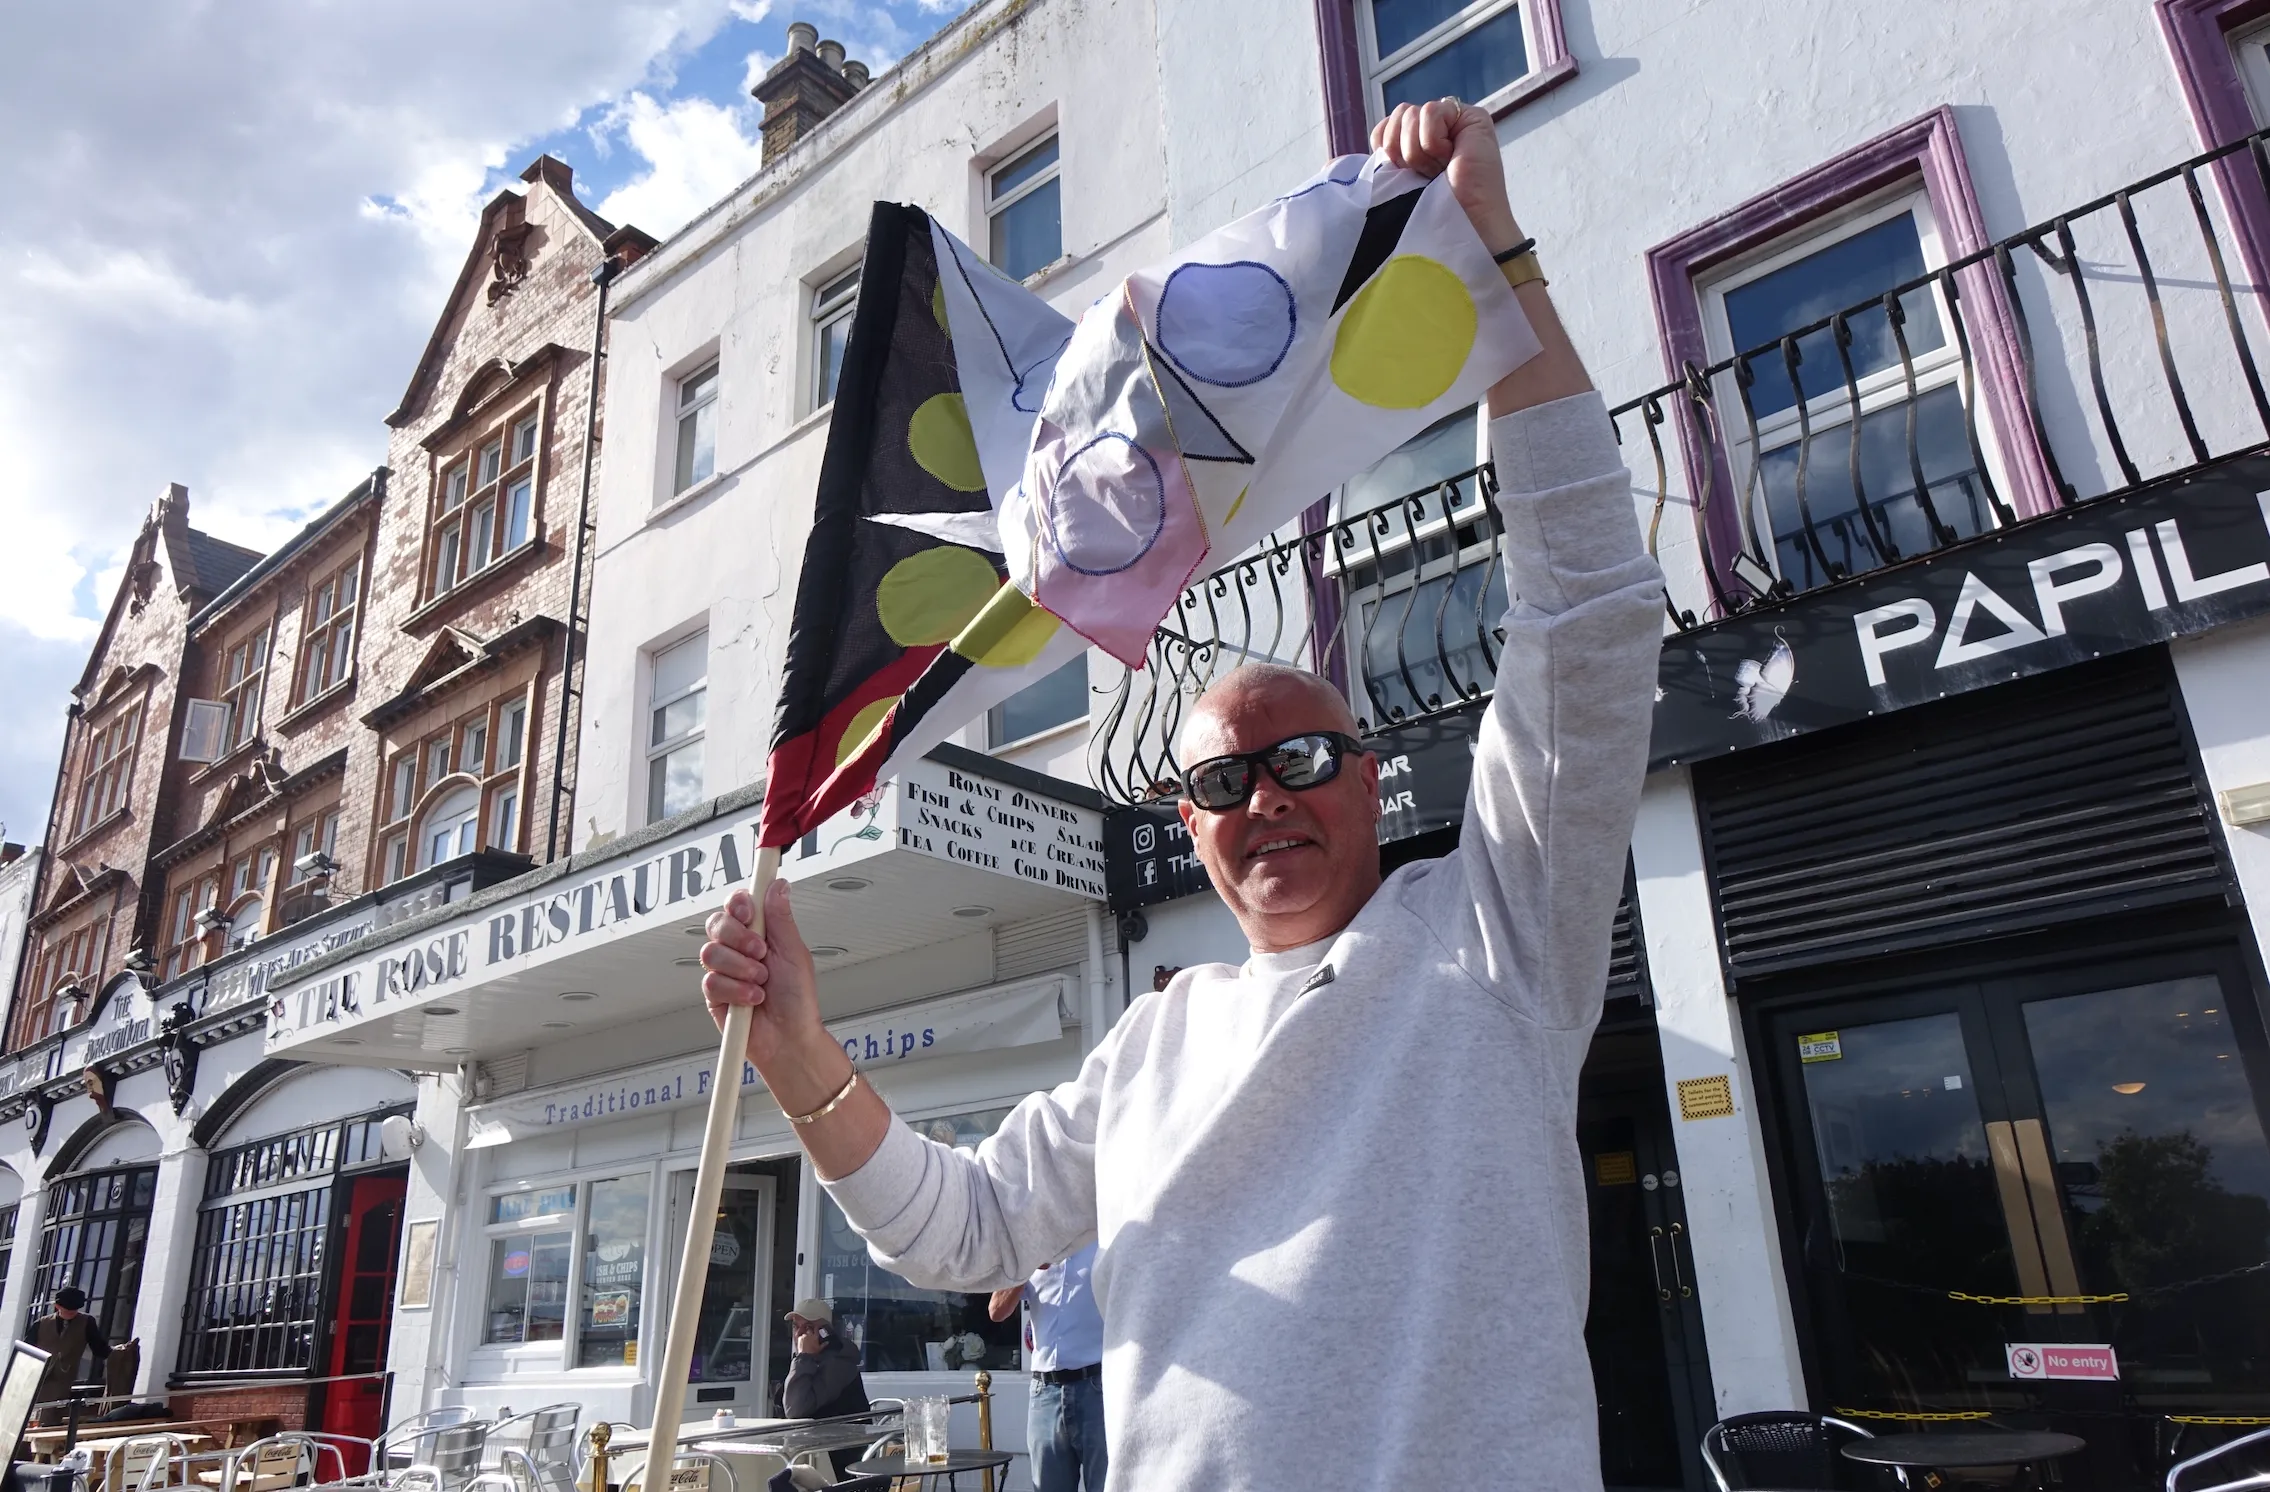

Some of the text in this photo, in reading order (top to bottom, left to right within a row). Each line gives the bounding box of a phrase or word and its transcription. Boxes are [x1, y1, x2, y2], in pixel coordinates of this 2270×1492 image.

[1854, 488, 2270, 688] PAPIL
[908, 781, 1104, 853] FISH & CHIPS SALAD
[948, 770, 1078, 824] ROAST DINNERS
[898, 826, 1104, 896] TEA COFFEE COLD DRINKS
[918, 807, 982, 839] SNACKS
[1047, 843, 1104, 873] CREAMS
[296, 970, 362, 1031] THE
[373, 928, 470, 1006] ROSE
[544, 1026, 935, 1126] Traditional Fh Chips
[712, 1243, 738, 1257] PEN
[2047, 1354, 2108, 1371] No entry
